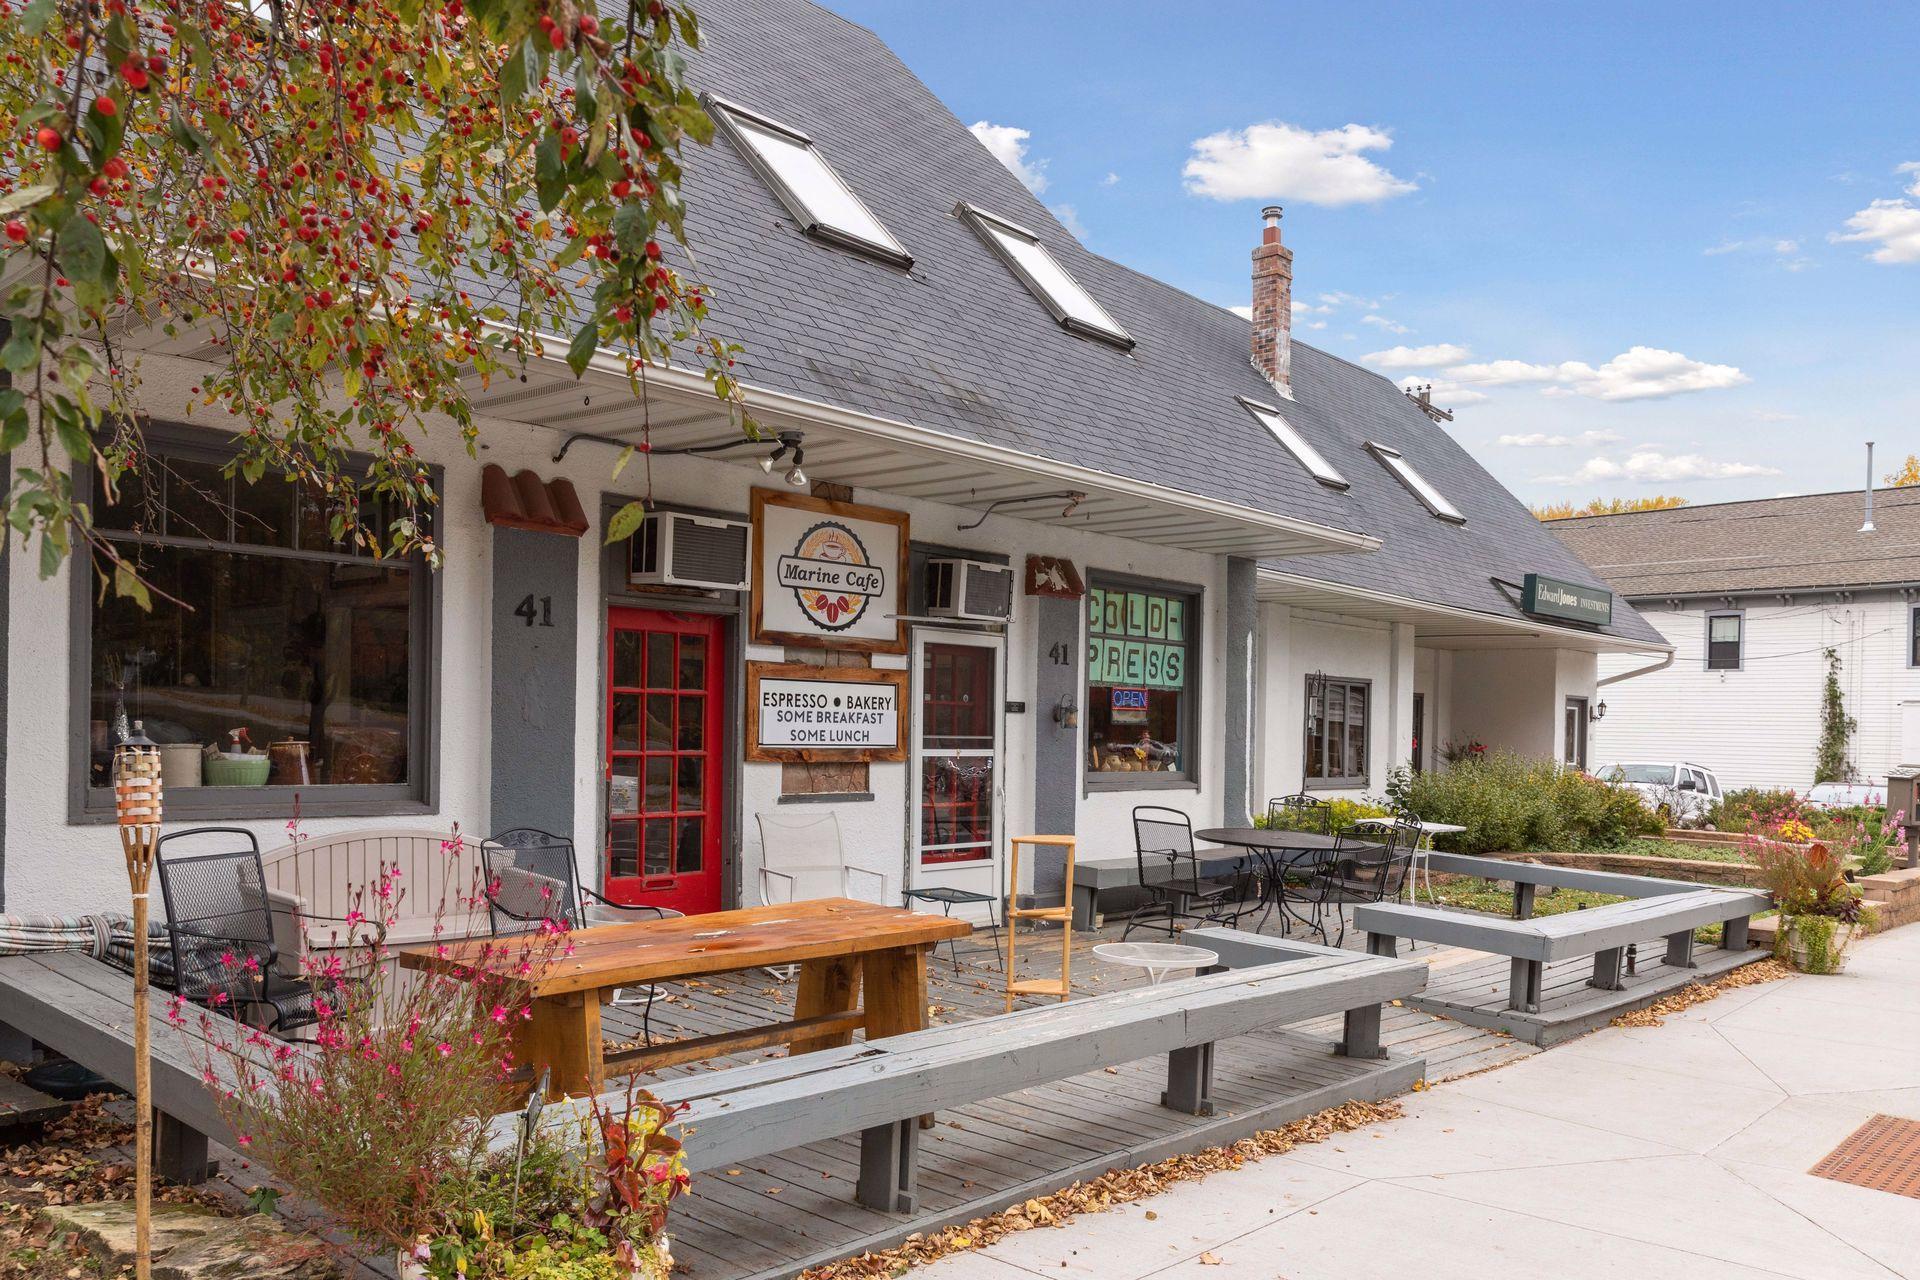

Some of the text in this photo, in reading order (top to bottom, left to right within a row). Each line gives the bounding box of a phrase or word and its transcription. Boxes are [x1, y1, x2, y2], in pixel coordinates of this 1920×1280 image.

[784, 563, 879, 590] Marine Cafe
[514, 594, 555, 627] 41
[1580, 598, 1609, 612] INVESTMENTS
[1049, 641, 1070, 666] 41
[1089, 644, 1180, 681] PRESS
[763, 692, 892, 711] ESPRESSO BAKERY
[1114, 690, 1146, 707] OPEN
[777, 710, 884, 725] SOME BREAKFAST
[790, 729, 870, 742] SOME LUNCH
